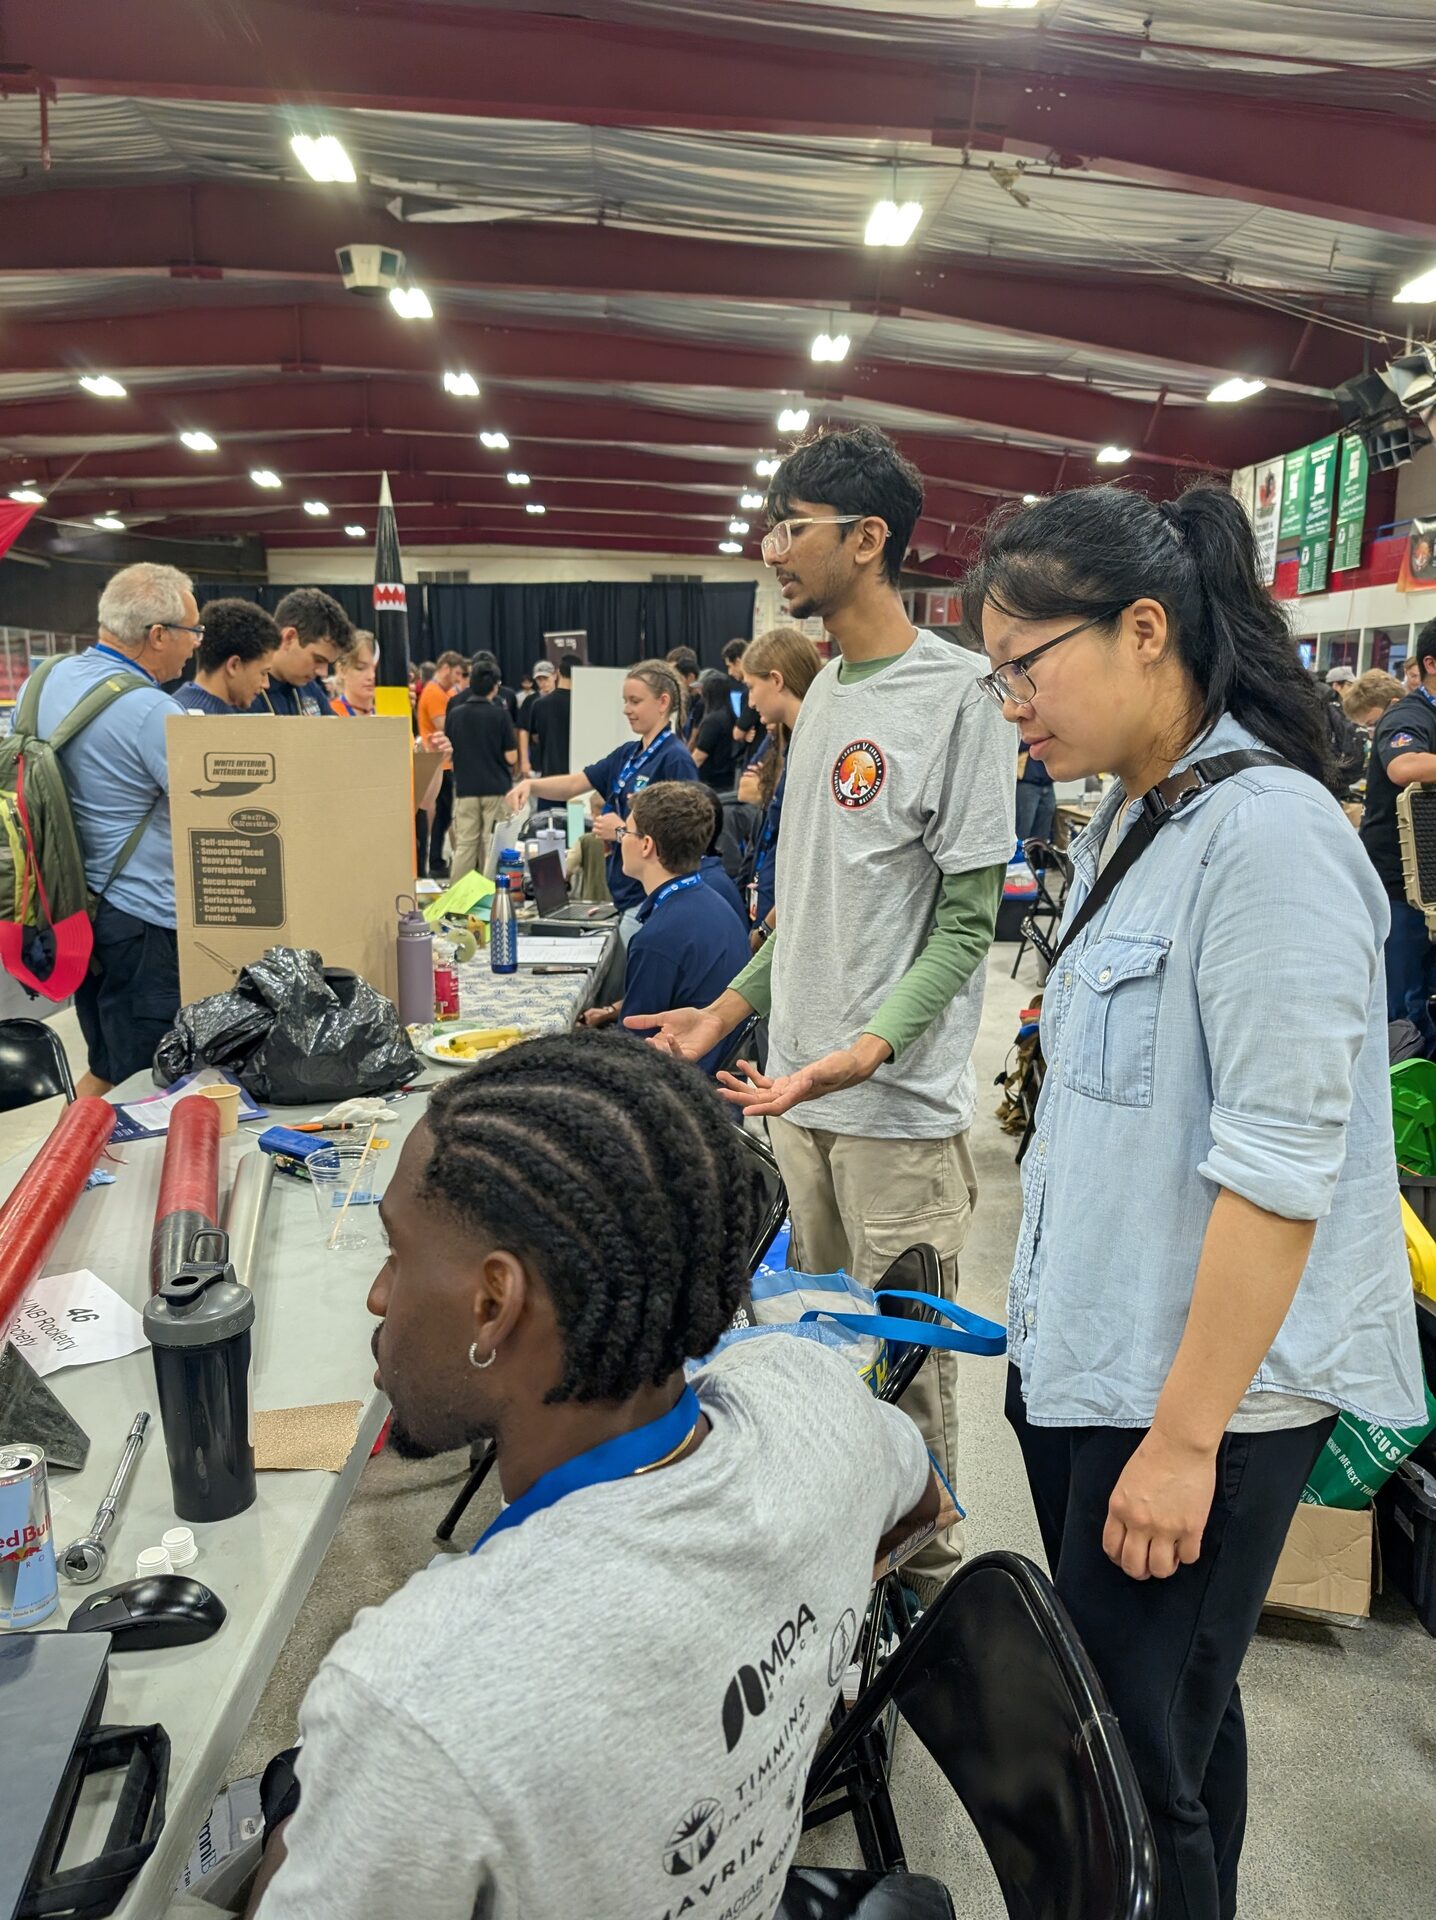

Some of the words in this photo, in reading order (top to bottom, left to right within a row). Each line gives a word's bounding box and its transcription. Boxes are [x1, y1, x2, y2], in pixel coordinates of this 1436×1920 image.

[236, 760, 267, 768] INTERIOR
[200, 838, 250, 848] Self-standing
[201, 847, 230, 856] Smooth
[230, 848, 264, 857] surfaced
[201, 856, 225, 866] Heavy
[225, 857, 242, 866] duty
[202, 866, 243, 875] corrugated
[244, 867, 267, 875] board
[203, 878, 226, 886] Aucun
[227, 879, 257, 887] support
[203, 887, 245, 895] nécessaire
[204, 896, 233, 904] Surface
[233, 896, 253, 905] lisse
[204, 905, 230, 913] Carton
[230, 906, 257, 914] ondulé
[205, 914, 237, 922] renforcé
[66, 1308, 100, 1323] 46
[34, 1317, 80, 1352] Rocketry
[1338, 1454, 1350, 1469] ME
[1346, 1466, 1362, 1487] NEXT
[22, 1512, 51, 1544] Bull
[760, 1603, 816, 1690] MDA
[734, 1696, 805, 1801] TIMMINS
[198, 1809, 217, 1875] mniB
[660, 1828, 765, 1920] AVRIK
